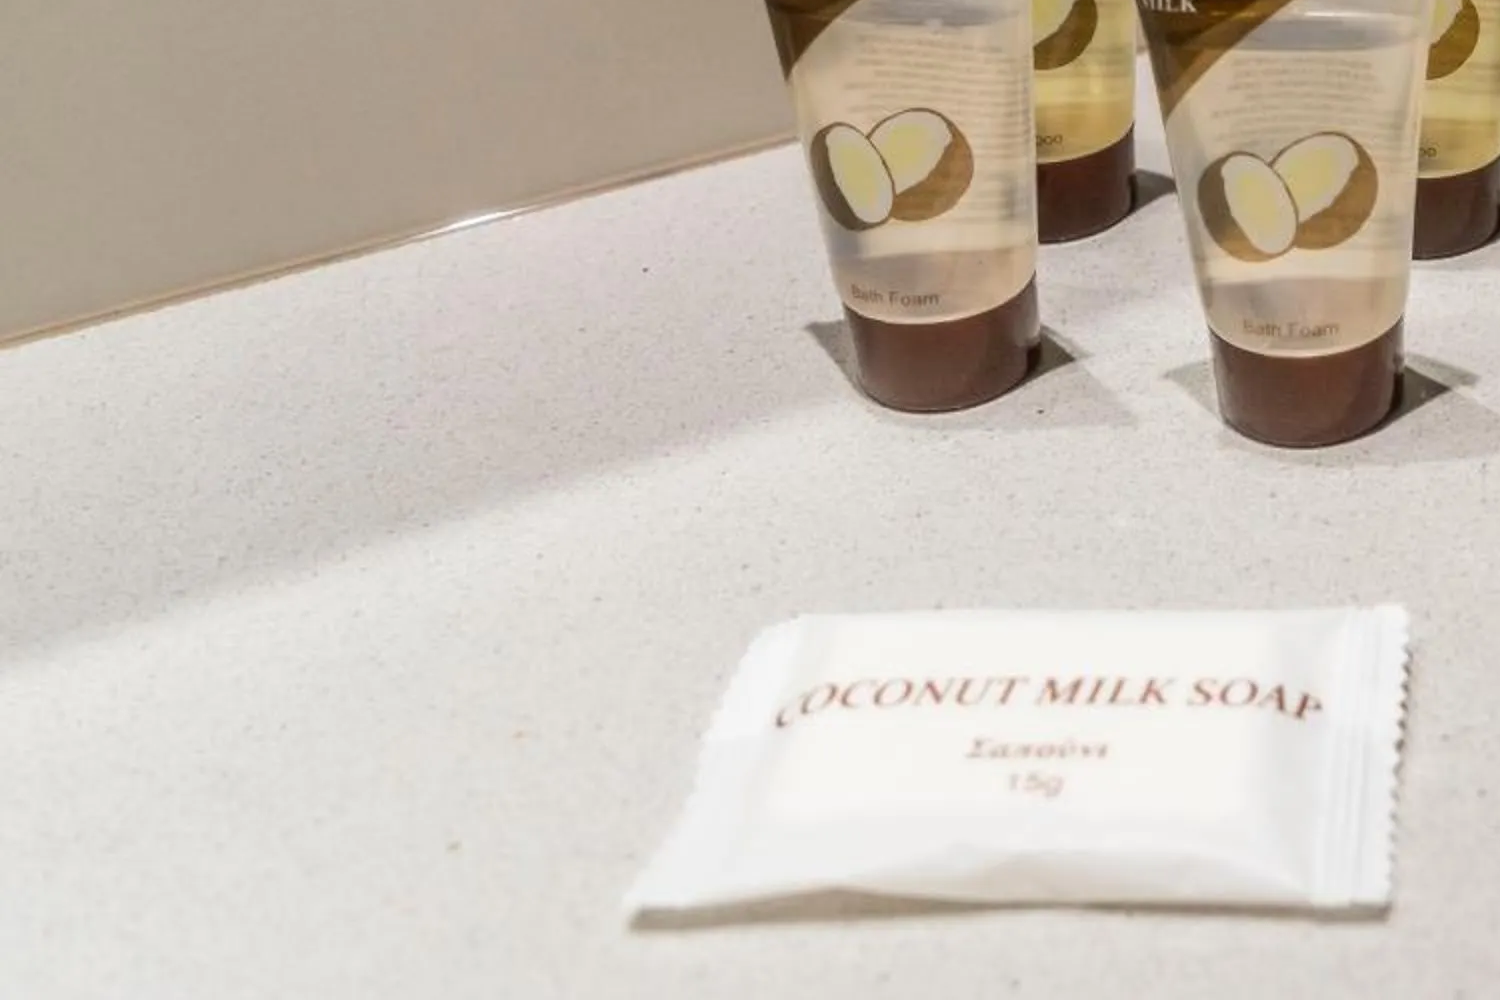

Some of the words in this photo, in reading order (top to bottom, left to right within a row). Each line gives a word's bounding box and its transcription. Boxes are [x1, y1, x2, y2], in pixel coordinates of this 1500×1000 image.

[775, 675, 1030, 729] COCONUT
[1034, 676, 1176, 707] MILK
[1186, 676, 1322, 720] SOAP
